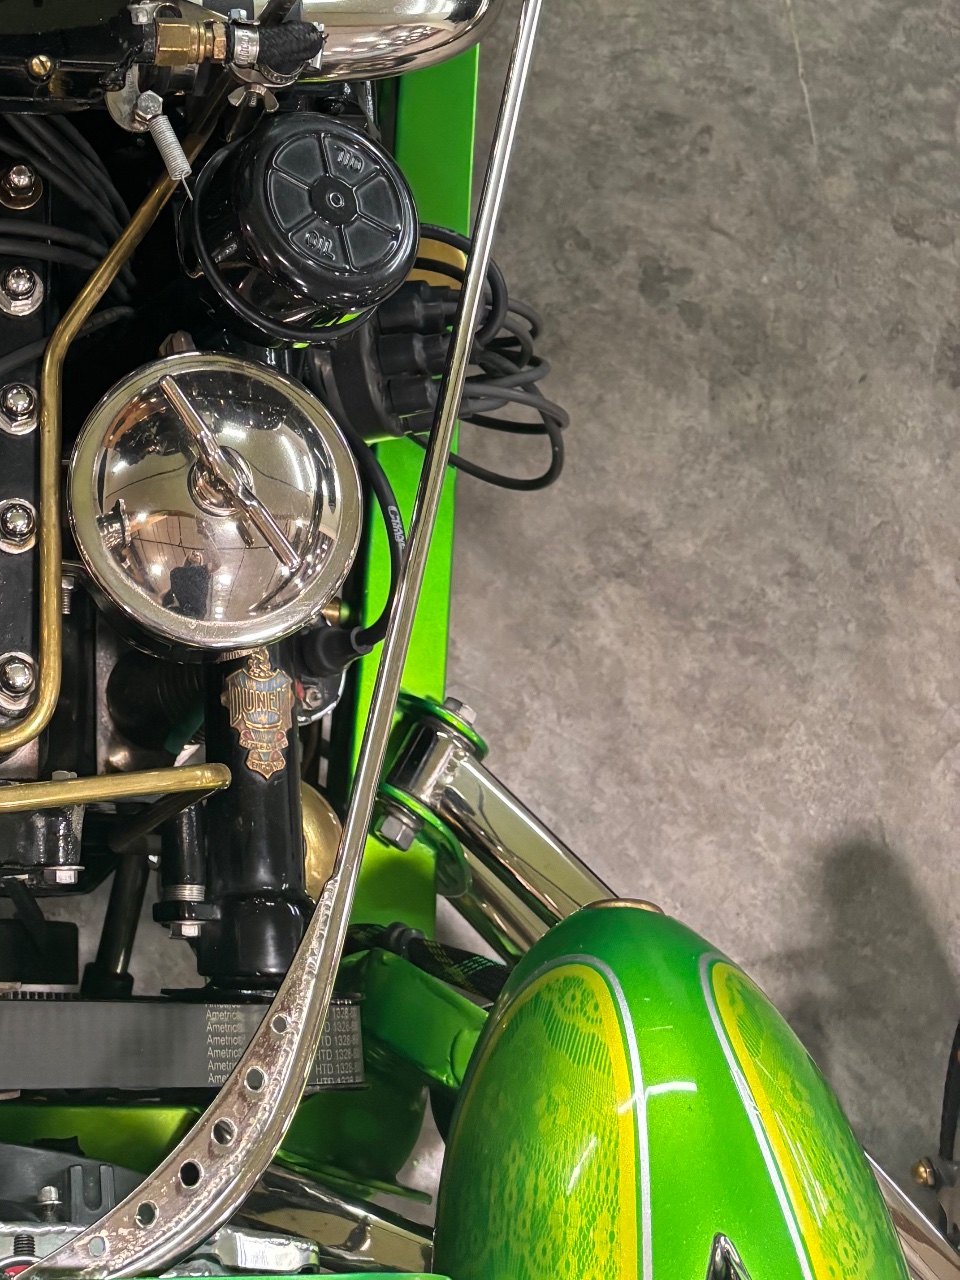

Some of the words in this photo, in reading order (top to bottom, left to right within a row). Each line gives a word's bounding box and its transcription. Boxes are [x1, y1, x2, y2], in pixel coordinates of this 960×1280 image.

[334, 144, 364, 173] OIL
[305, 229, 336, 260] OIL
[315, 1063, 334, 1075] HTD
